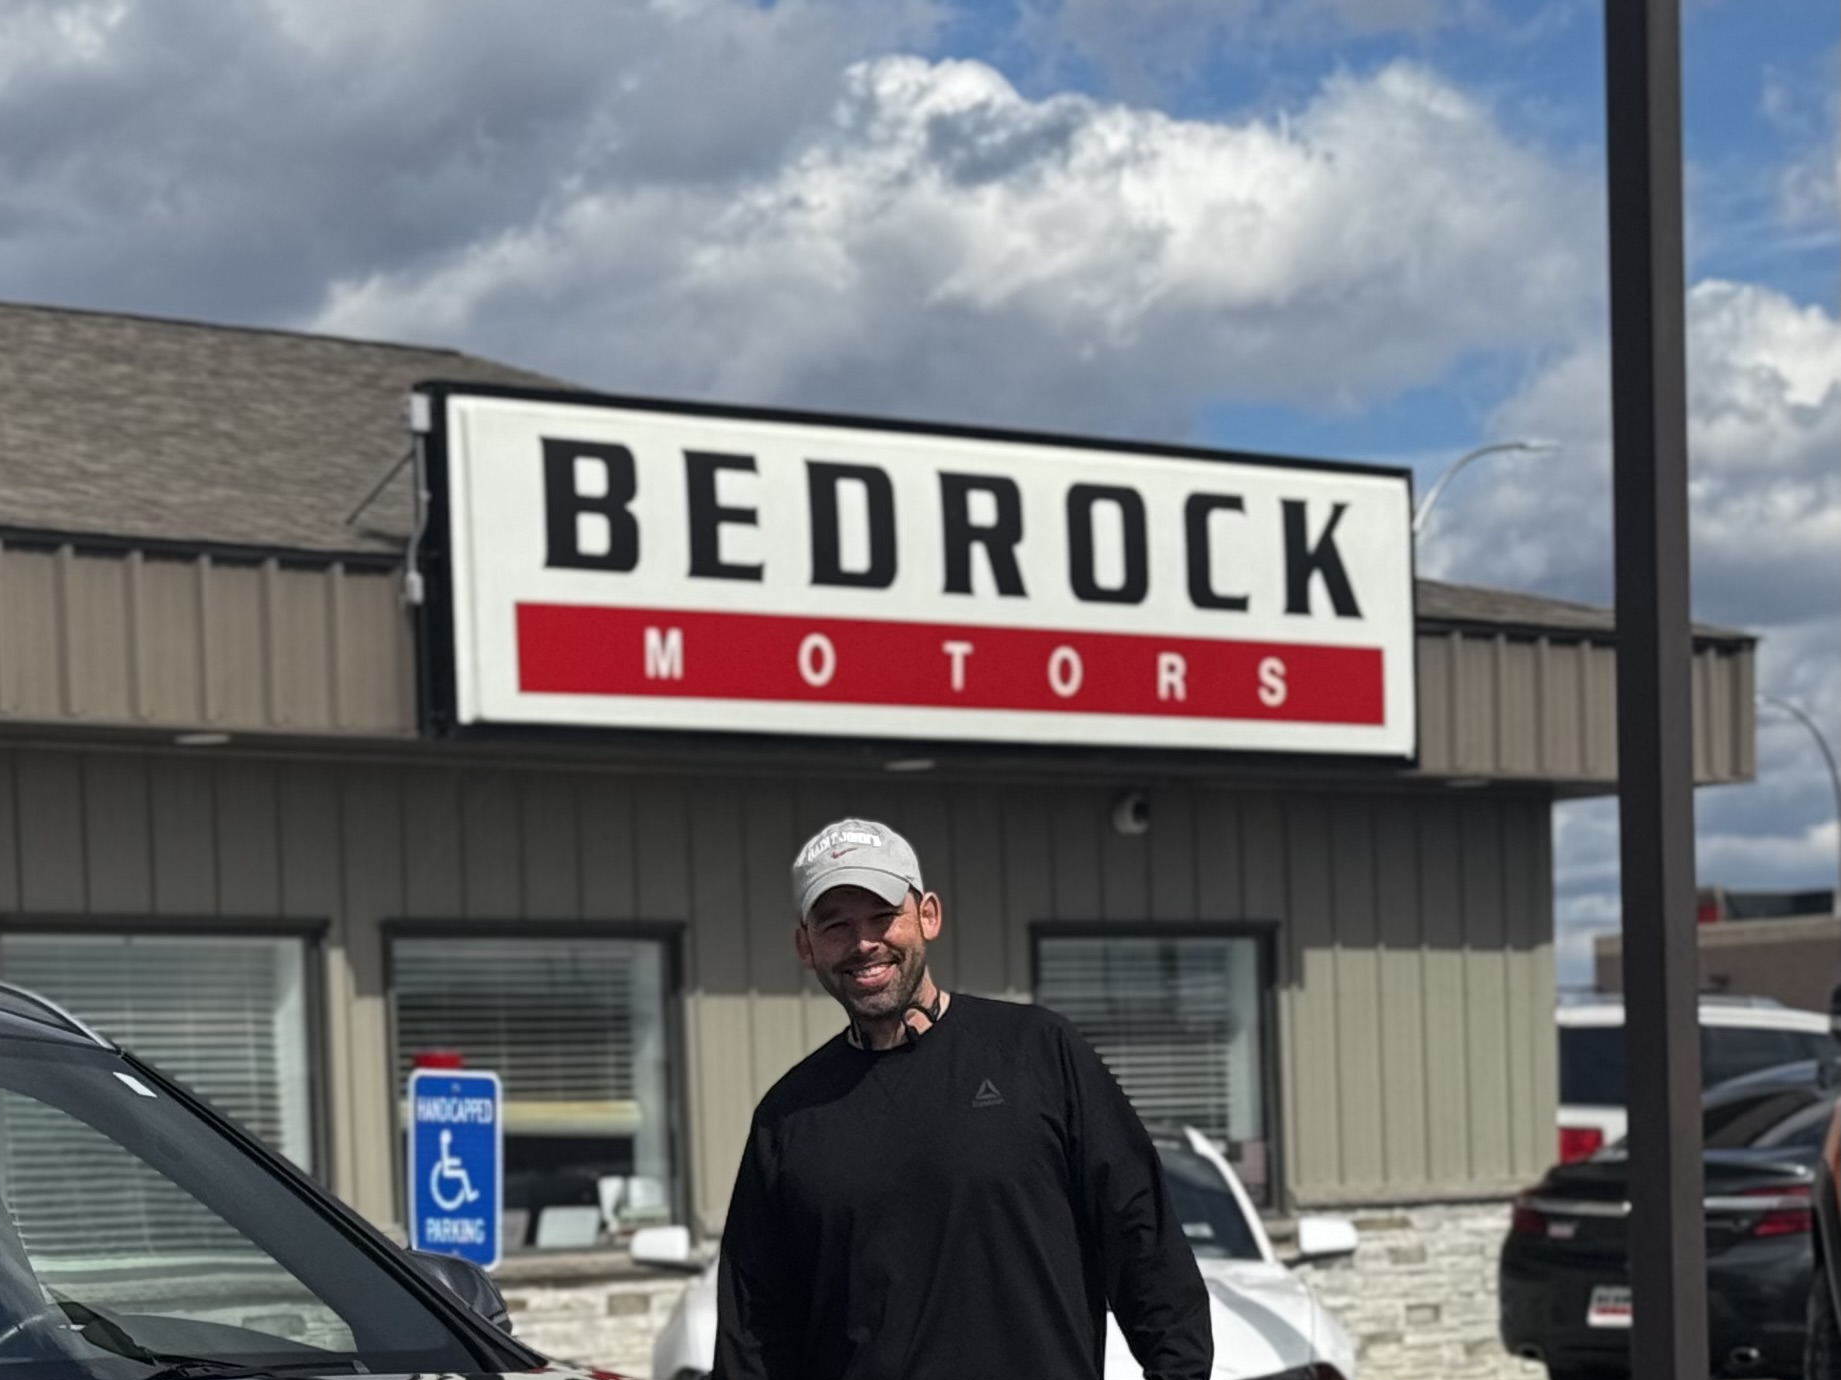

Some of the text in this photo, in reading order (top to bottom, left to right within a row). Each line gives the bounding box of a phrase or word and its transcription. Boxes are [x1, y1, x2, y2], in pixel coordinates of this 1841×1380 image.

[539, 435, 1364, 620] BEDROCK
[643, 625, 1288, 707] MOTORS
[416, 1096, 494, 1125] HANDICAPPED
[425, 1217, 486, 1244] PARKING
